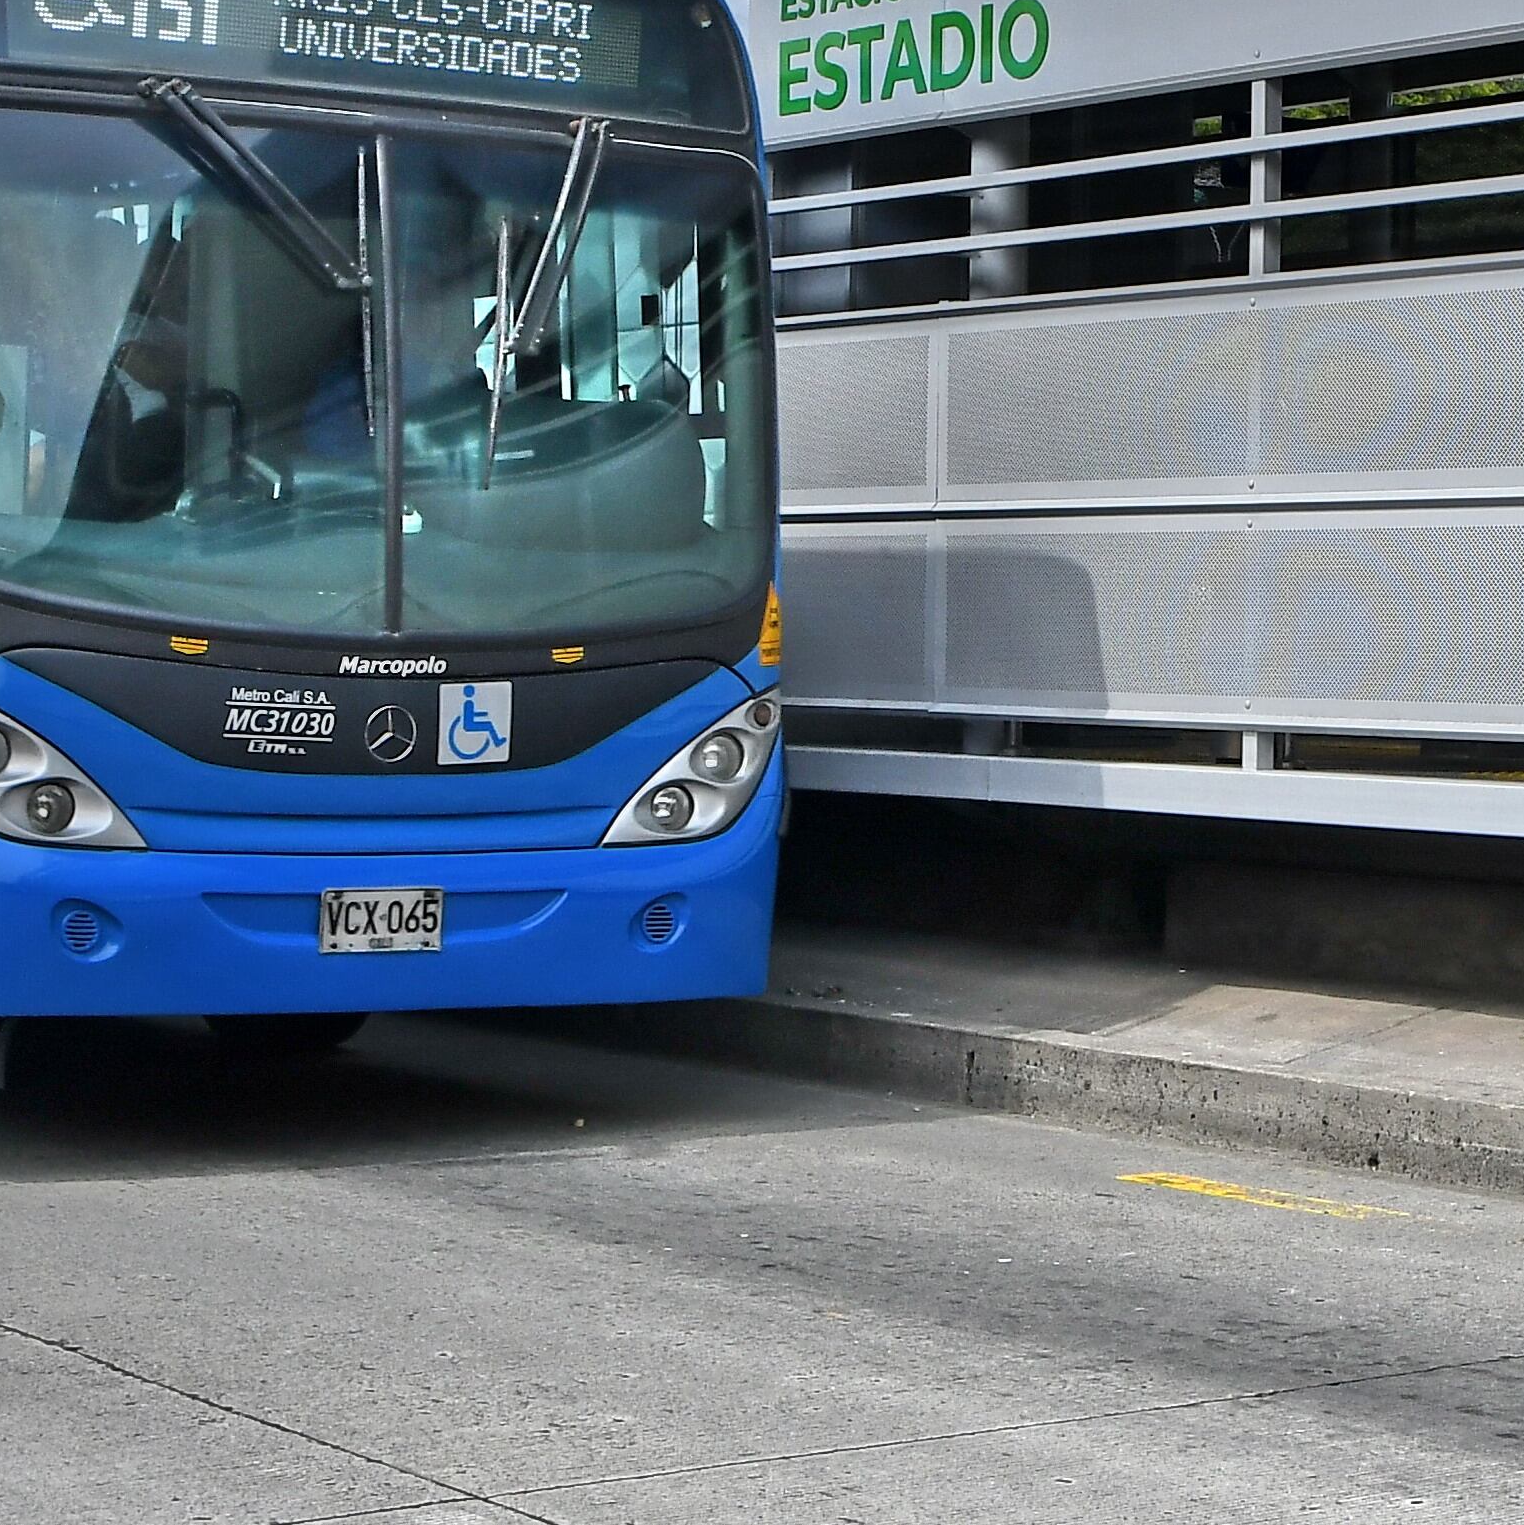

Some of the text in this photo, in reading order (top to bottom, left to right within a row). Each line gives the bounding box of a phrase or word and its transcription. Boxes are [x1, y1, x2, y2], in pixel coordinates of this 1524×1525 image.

[279, 16, 581, 82] UNIVERSIDADES
[339, 655, 447, 677] Marcopolo
[231, 687, 332, 705] Metro Cali S.A.
[225, 708, 336, 736] MC31030
